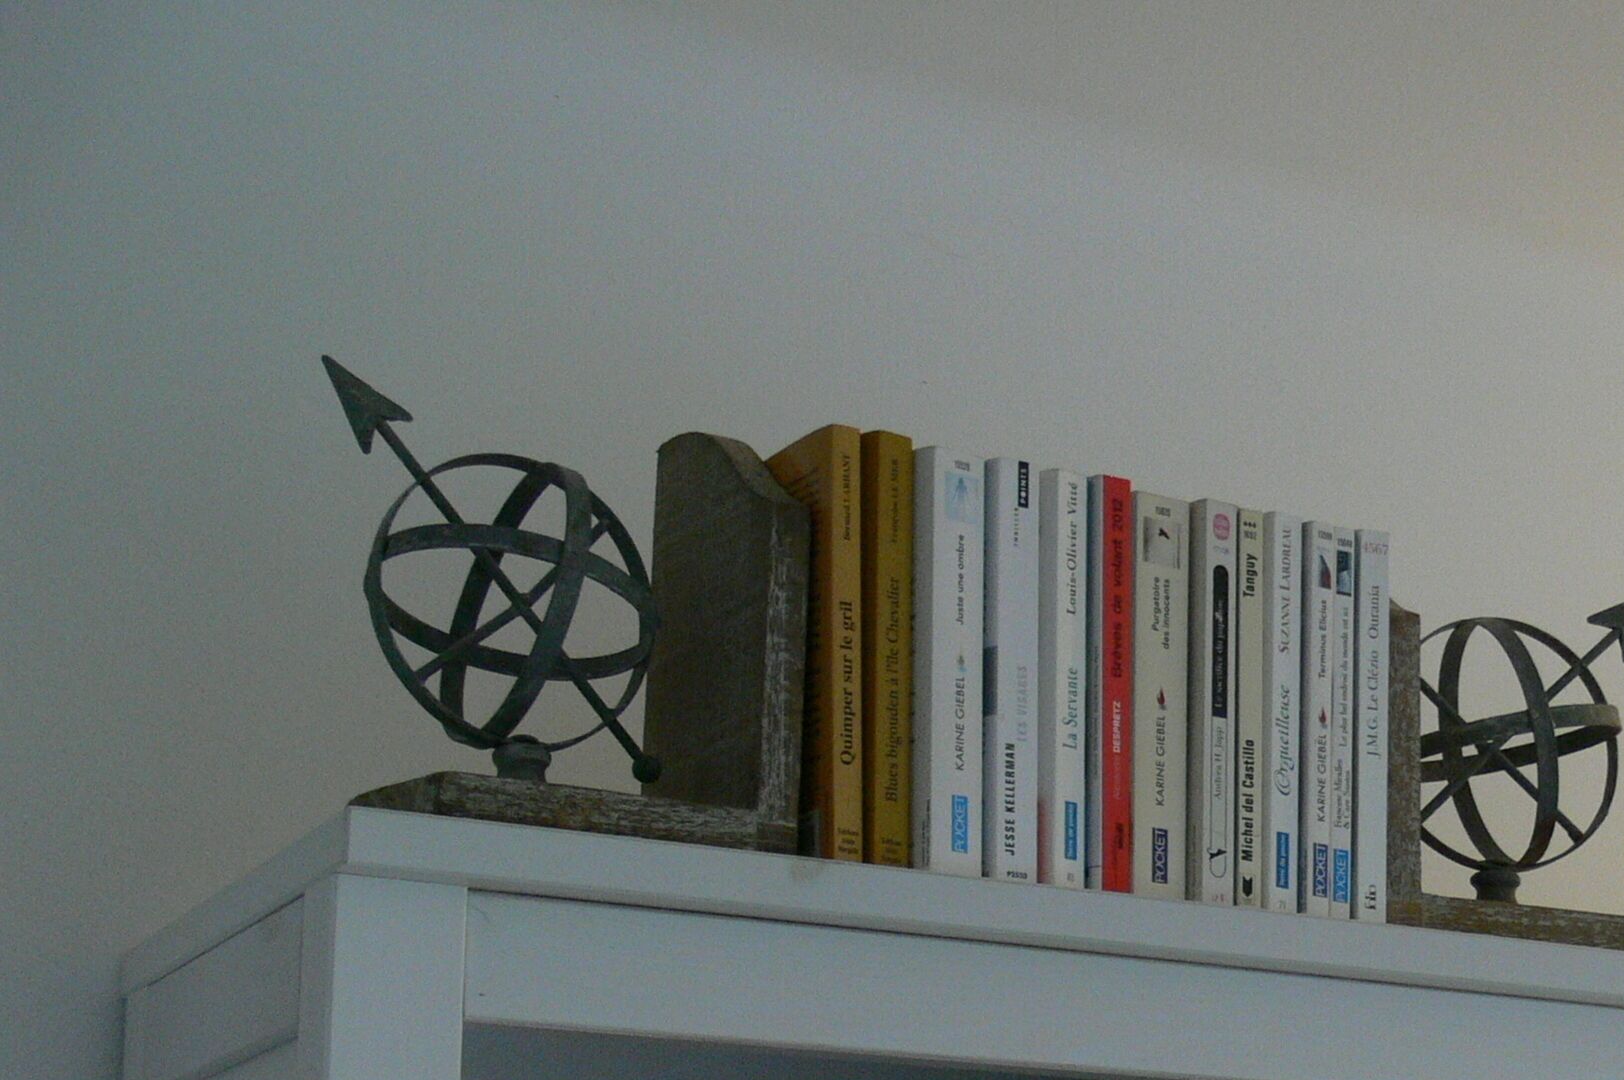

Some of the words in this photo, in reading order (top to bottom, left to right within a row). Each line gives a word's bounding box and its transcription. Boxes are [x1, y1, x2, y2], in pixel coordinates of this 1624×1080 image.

[1066, 482, 1078, 515] Vitté
[1111, 498, 1123, 532] 2012
[955, 534, 965, 570] ombre
[1065, 521, 1078, 615] Louis-Olivier
[1111, 538, 1123, 588] volant
[956, 573, 964, 594] une
[1241, 553, 1258, 599] Tanguy
[839, 601, 856, 632] gril
[886, 576, 900, 644] Chevalier
[955, 596, 965, 626] Juste
[1151, 577, 1161, 632] Purgatoire
[1162, 578, 1170, 631] innocents
[1278, 594, 1291, 655] SUZANNE
[1318, 599, 1328, 632] Elicius
[1366, 584, 1380, 640] Ourania
[840, 636, 853, 651] le
[885, 648, 898, 674] l'île
[1162, 633, 1170, 650] des
[1317, 634, 1328, 679] Terminus
[843, 655, 853, 683] sur
[885, 678, 898, 687] à
[1366, 649, 1380, 691] Clézio
[954, 676, 966, 720] GIEBEL
[1061, 666, 1078, 728] Servante
[1366, 693, 1379, 712] Le
[840, 688, 855, 766] Quimper
[885, 691, 900, 759] bigouden
[1062, 733, 1078, 750] La
[1112, 700, 1122, 754] DESPRETZ
[1155, 715, 1166, 757] GIEBEL
[1273, 684, 1295, 797] Orgueilleuse
[1366, 715, 1381, 757] J.M.G.
[954, 724, 966, 772] KARINE
[1241, 738, 1256, 789] Castillo
[1316, 733, 1328, 775] GIEBEL
[885, 763, 898, 803] Blues
[1004, 742, 1016, 814] KELLERMAN
[1155, 761, 1166, 807] KARINE
[1316, 777, 1327, 823] KARINE
[953, 795, 967, 853] POCKET
[1241, 793, 1255, 814] del
[1004, 818, 1016, 857] JESSE
[1153, 829, 1167, 883] POCKET
[1241, 816, 1254, 863] Michel
[1315, 844, 1328, 897] POCKET
